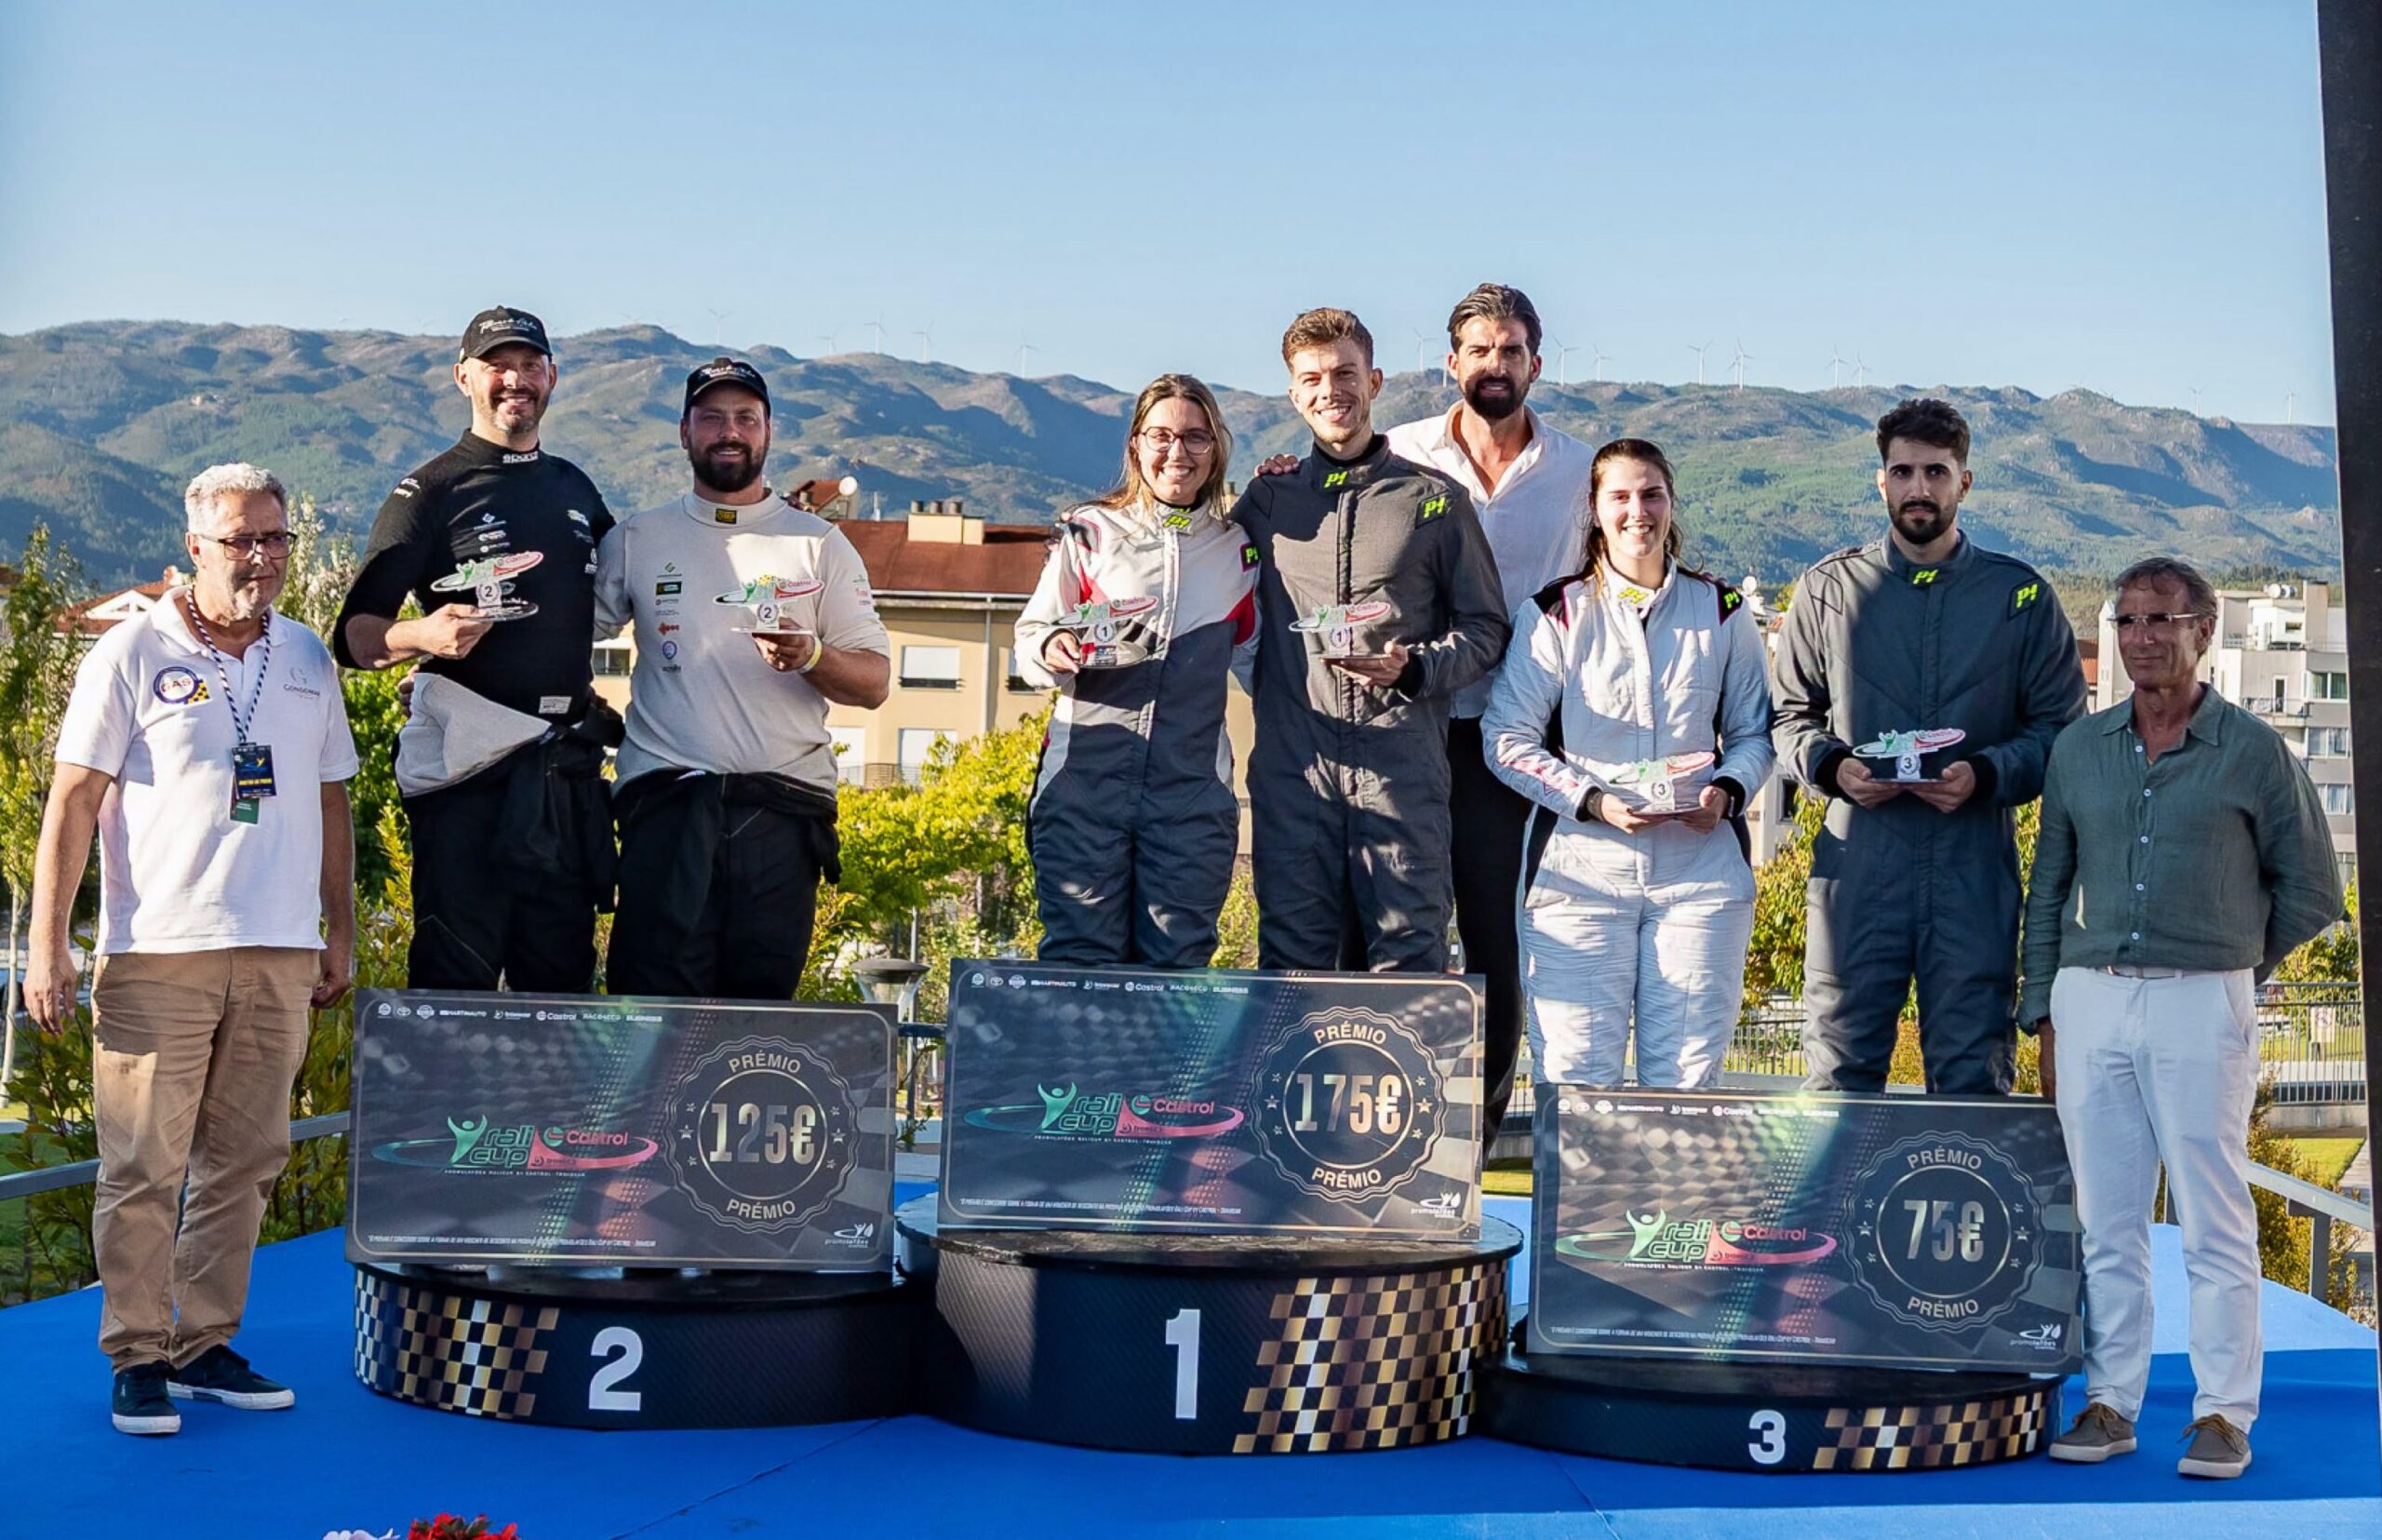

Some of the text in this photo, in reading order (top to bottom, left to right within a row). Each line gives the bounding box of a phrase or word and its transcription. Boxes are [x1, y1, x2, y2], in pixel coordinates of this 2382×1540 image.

[484, 586, 493, 597] 2
[764, 607, 772, 619] 2
[1101, 626, 1108, 637] 1
[1336, 631, 1343, 642] 1
[1903, 757, 1913, 769] 3
[1658, 783, 1666, 796] 3
[547, 1012, 577, 1021] Castrol
[1313, 1020, 1387, 1046] PRÉMIO
[728, 1050, 802, 1075] PRÉMIO
[1073, 1092, 1123, 1114] rali
[1153, 1098, 1214, 1114] Castrol
[1294, 1074, 1402, 1133] 175€
[710, 1102, 816, 1163] 125€
[1058, 1114, 1117, 1135] cup
[484, 1125, 536, 1147] rali
[566, 1130, 629, 1145] Castrol
[469, 1145, 529, 1169] cup
[1907, 1146, 1983, 1172] PRÉMIO
[1312, 1166, 1382, 1190] PRÉMIO
[726, 1198, 796, 1221] PRÉMIO
[1663, 1219, 1713, 1242] rali
[1744, 1225, 1806, 1241] Castrol
[1903, 1199, 1985, 1263] 75€
[1648, 1241, 1706, 1263] cup
[1907, 1295, 1979, 1320] PRÉMIO
[588, 1326, 643, 1412] 2
[1165, 1307, 1201, 1420] 1
[1748, 1409, 1786, 1465] 3
